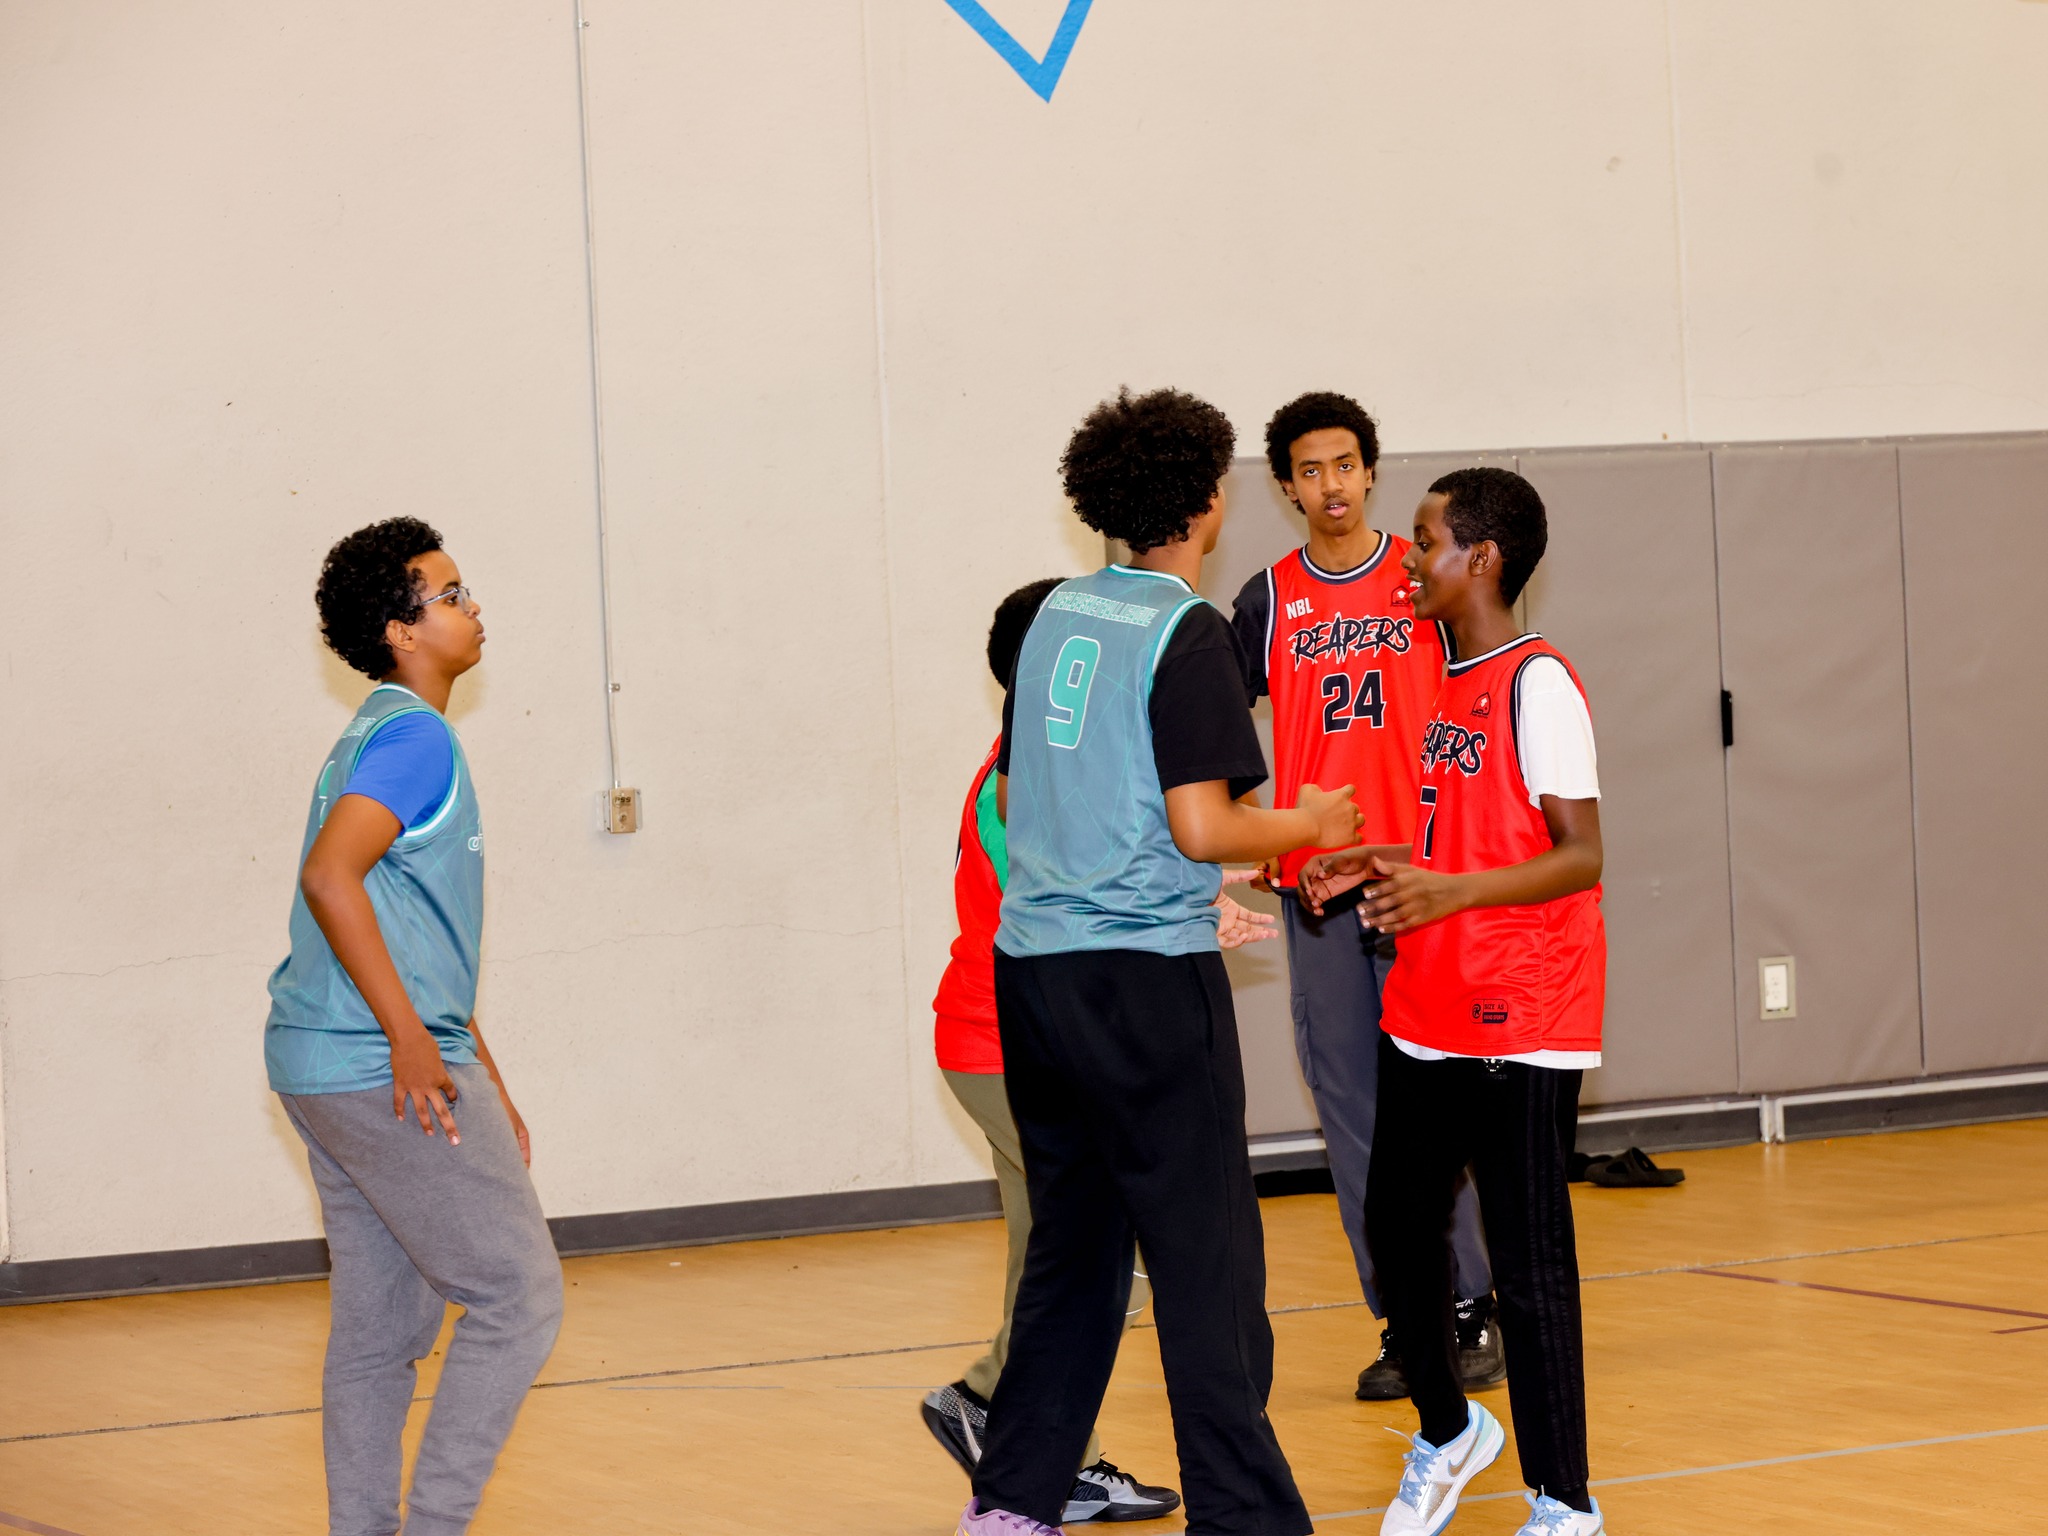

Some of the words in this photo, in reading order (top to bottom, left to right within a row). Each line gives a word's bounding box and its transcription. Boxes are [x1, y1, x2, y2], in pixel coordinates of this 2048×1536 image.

[1285, 597, 1314, 620] NBL
[1288, 611, 1413, 672] REAPERS
[1045, 635, 1100, 749] 9
[1320, 669, 1387, 734] 24
[1419, 785, 1438, 859] 7
